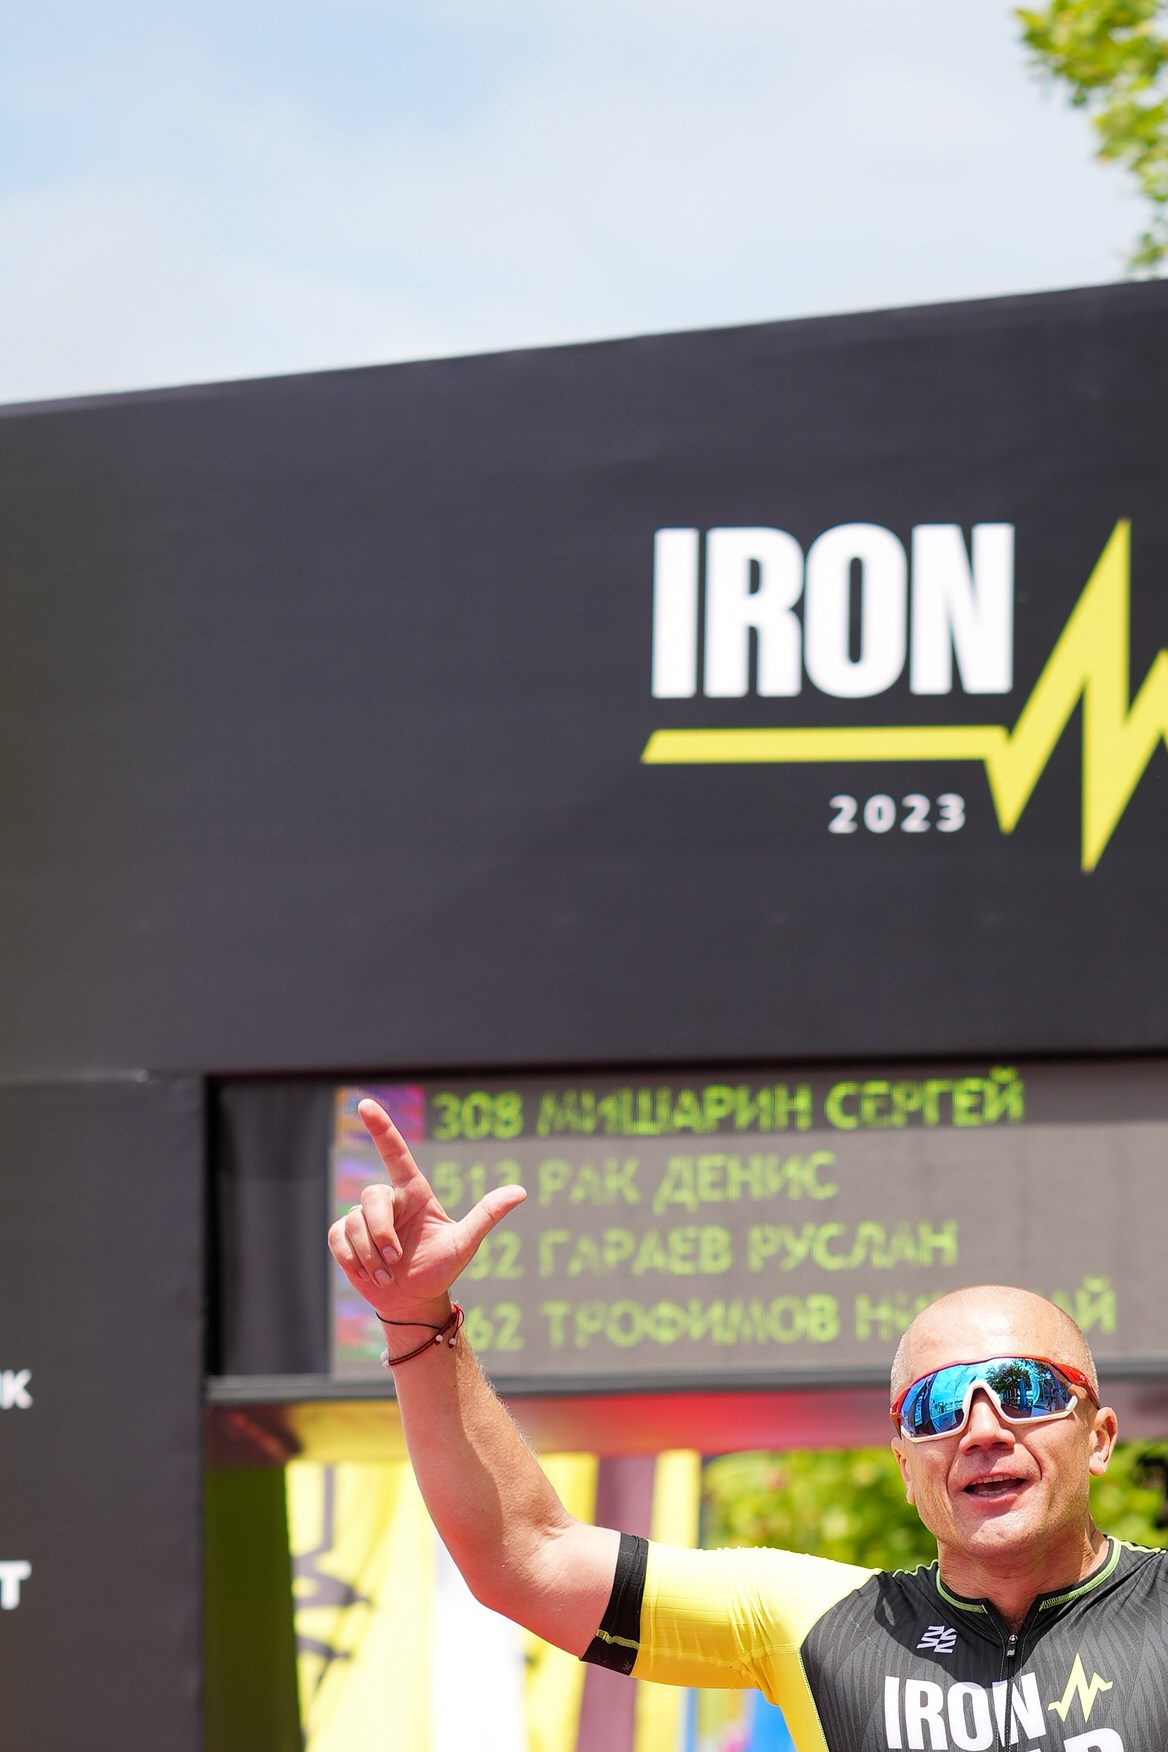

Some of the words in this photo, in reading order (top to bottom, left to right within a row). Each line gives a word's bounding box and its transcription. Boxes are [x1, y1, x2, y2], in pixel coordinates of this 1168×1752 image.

[652, 523, 1014, 698] IRON
[828, 794, 966, 834] 2023
[432, 1090, 524, 1140] 308
[825, 1065, 1025, 1130] СЕРГЕЙ
[537, 1155, 642, 1207] РАК
[652, 1150, 838, 1216] ДЕНИС
[538, 1222, 734, 1279] ГАРАЕВ
[748, 1218, 958, 1273] РУСЛАН
[884, 1671, 1048, 1752] IRON
